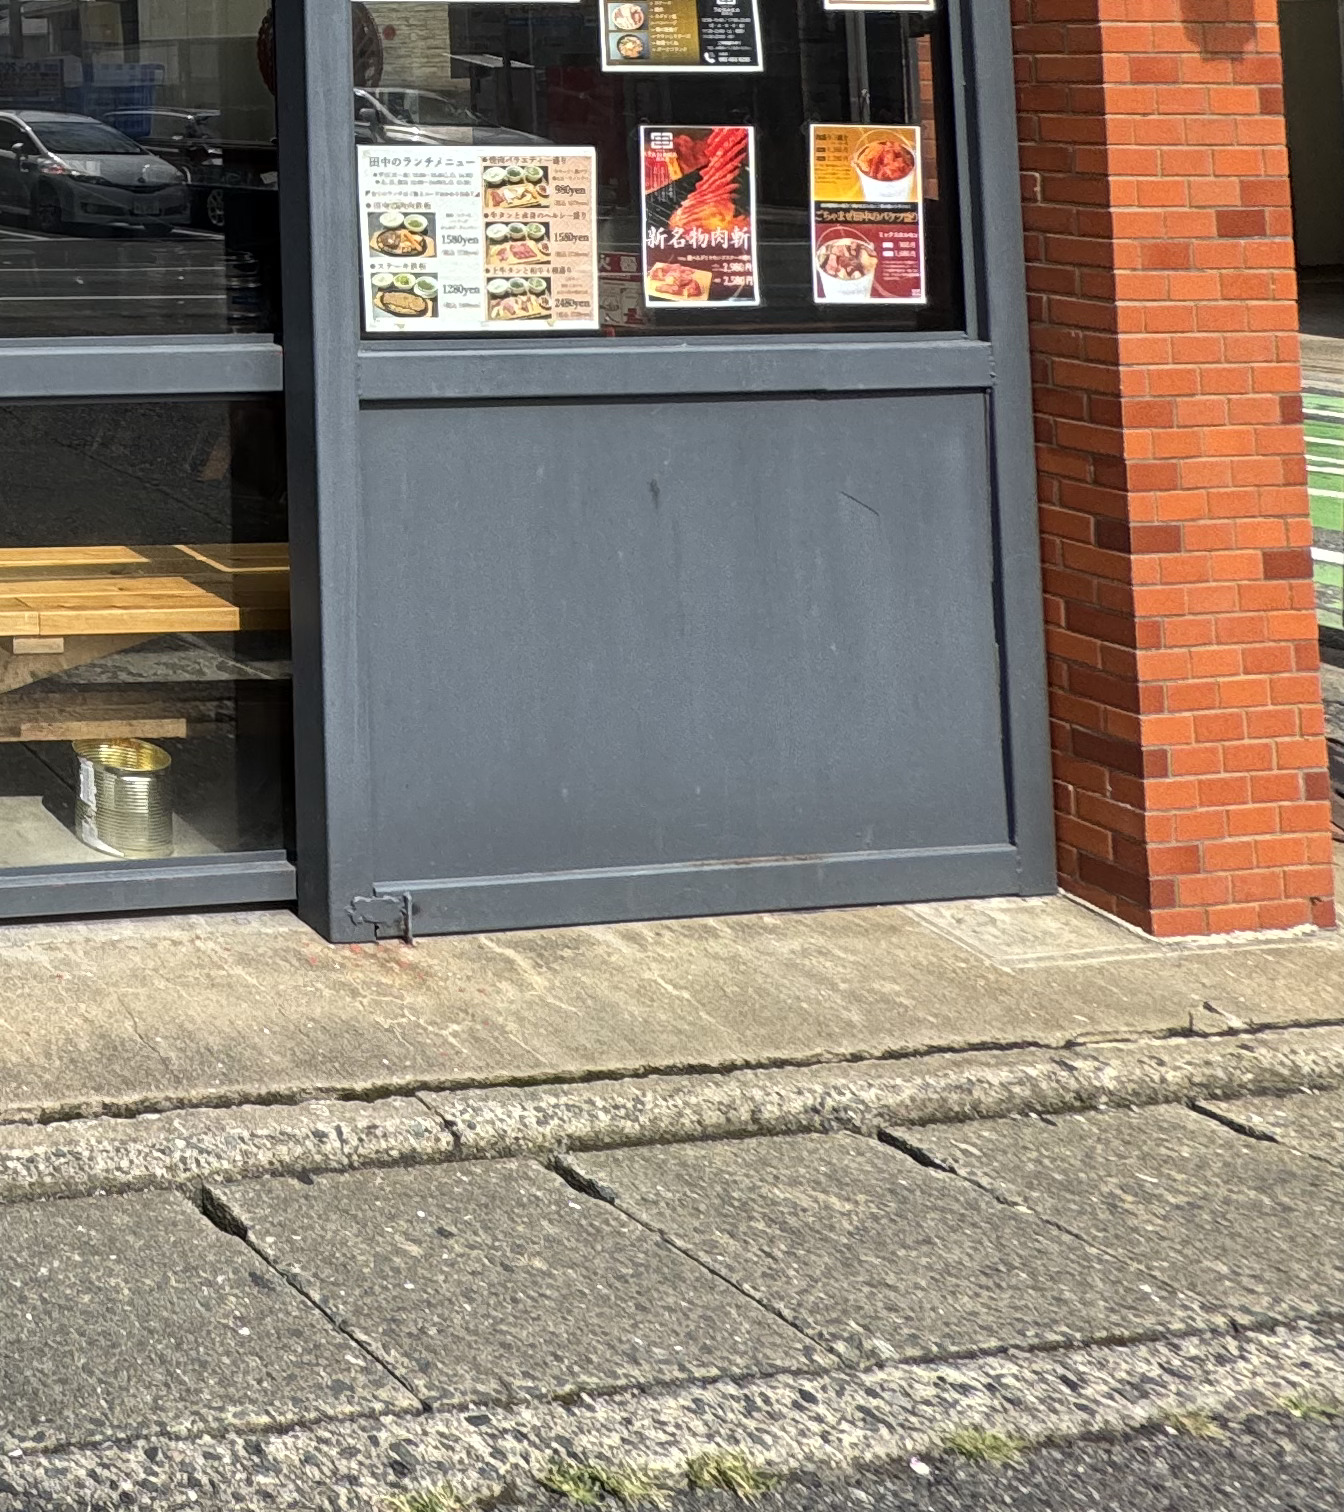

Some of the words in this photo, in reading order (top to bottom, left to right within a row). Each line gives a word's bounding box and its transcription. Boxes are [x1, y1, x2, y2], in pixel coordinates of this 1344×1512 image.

[369, 156, 476, 168] 田中のランチメニュー
